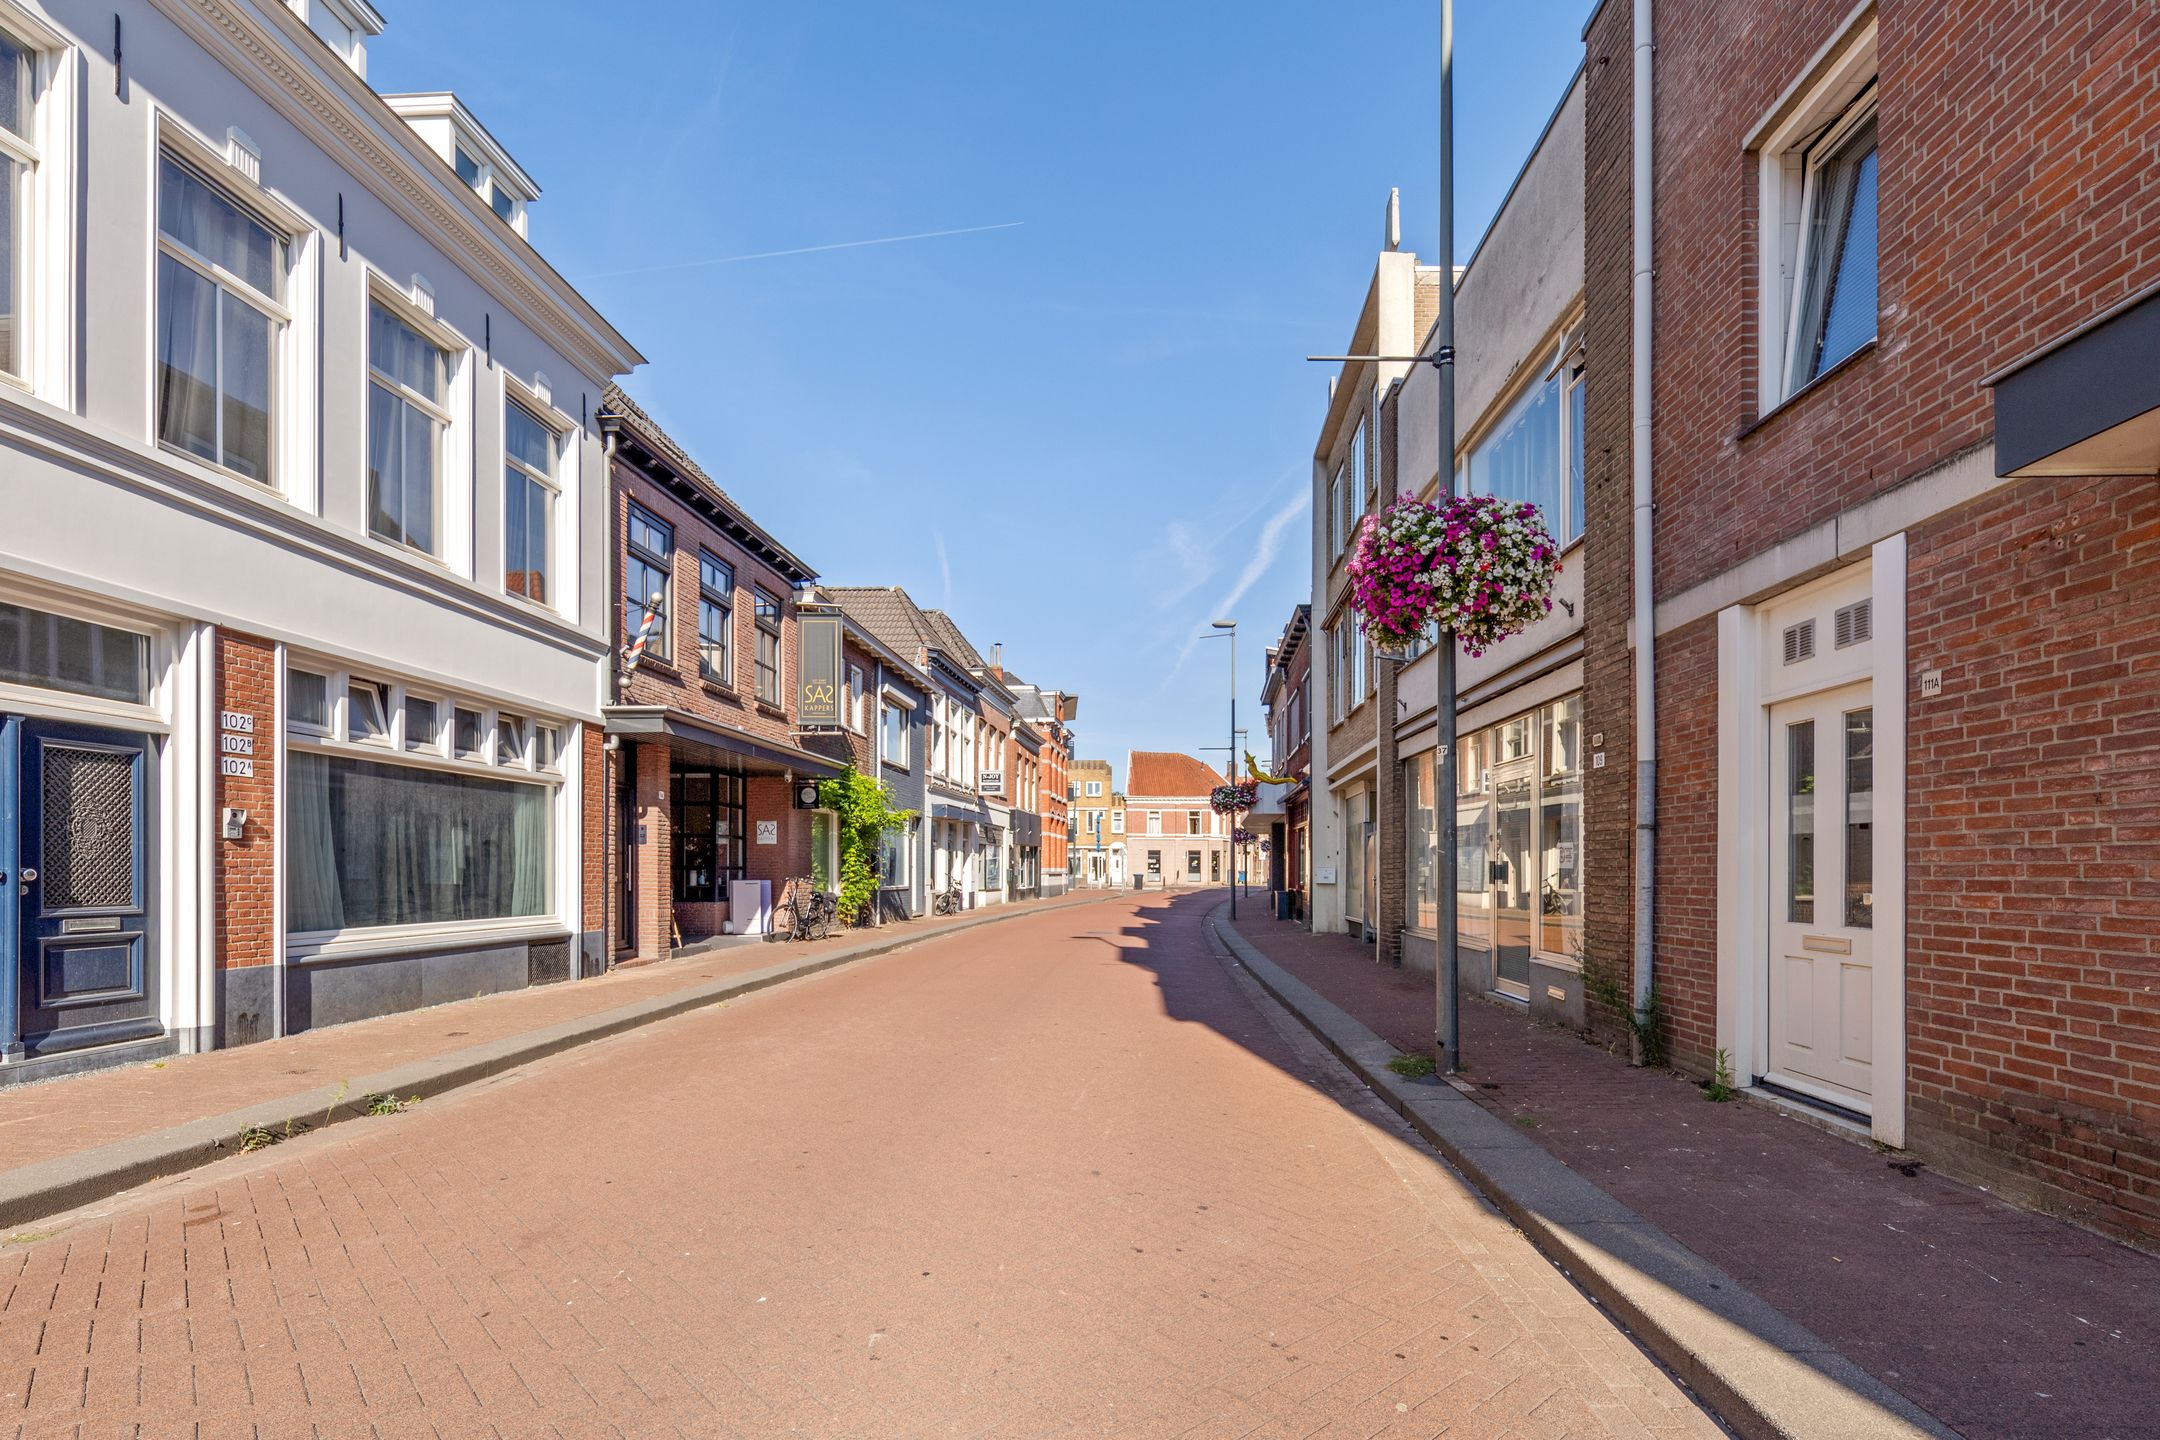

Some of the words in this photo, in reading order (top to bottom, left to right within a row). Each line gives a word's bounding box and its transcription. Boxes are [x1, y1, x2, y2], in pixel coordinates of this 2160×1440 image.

[1924, 677, 1940, 691] 111A
[805, 685, 834, 704] SAS
[757, 823, 776, 836] SAS
